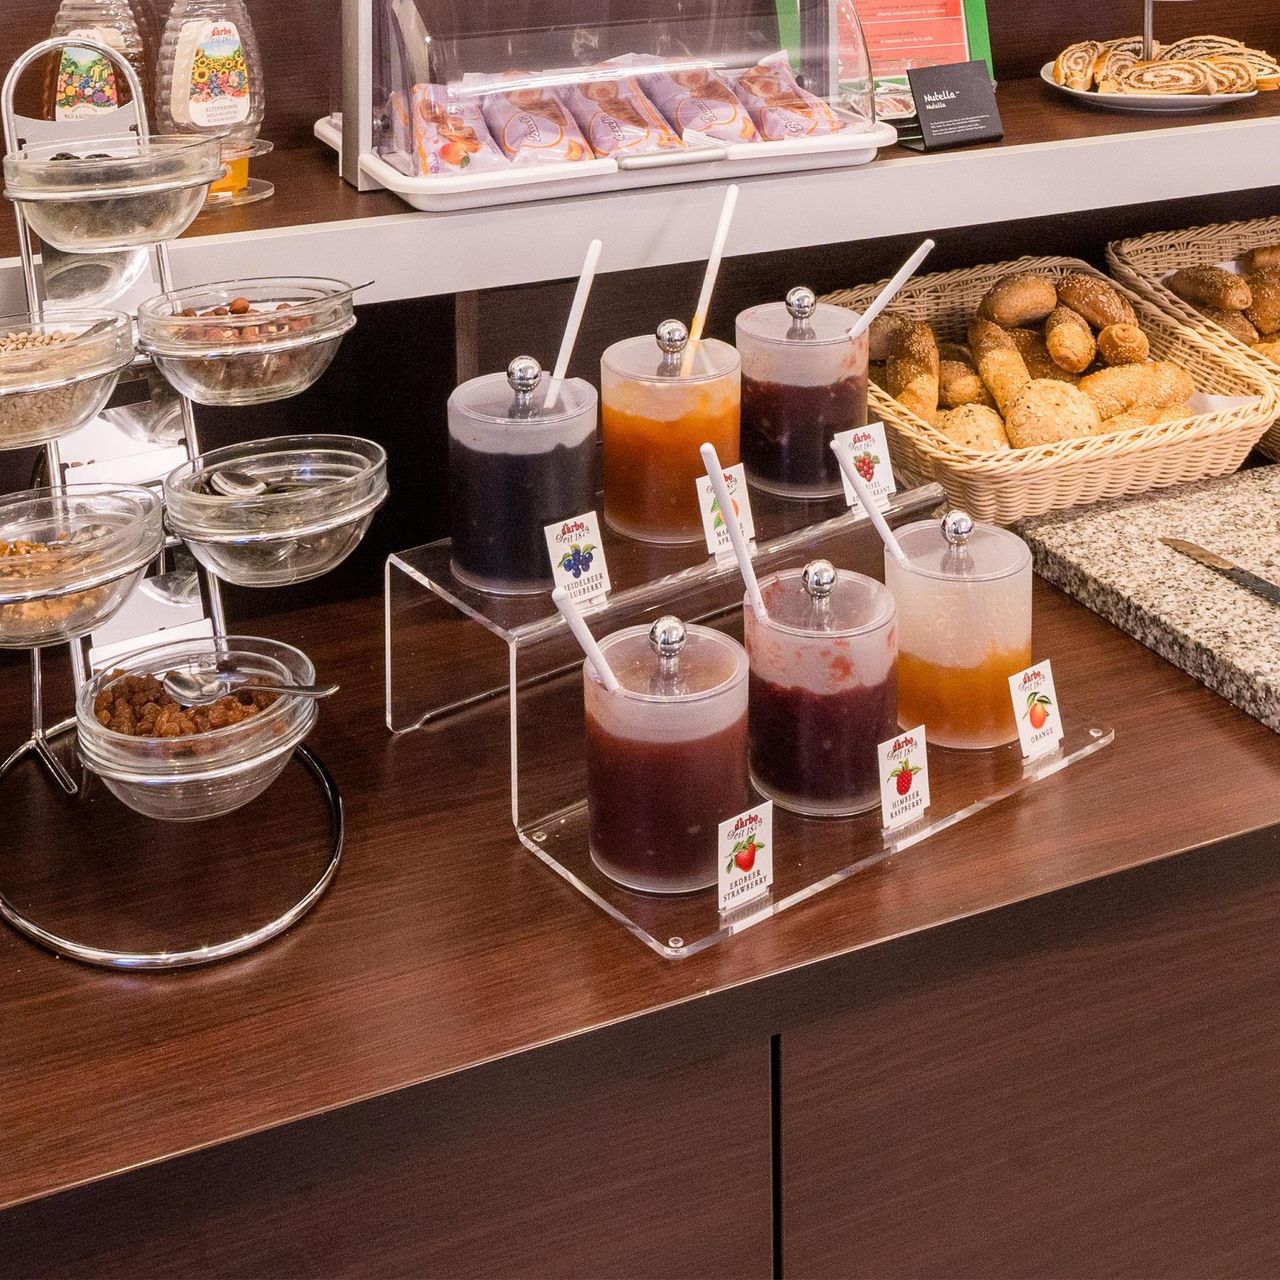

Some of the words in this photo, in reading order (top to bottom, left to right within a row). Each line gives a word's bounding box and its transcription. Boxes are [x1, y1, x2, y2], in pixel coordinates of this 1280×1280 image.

[924, 90, 956, 103] Nutella
[1030, 727, 1054, 744] ORANGE
[890, 799, 923, 820] RASPBERRY
[891, 790, 920, 809] HIMBEER
[723, 875, 768, 903] STRAWBERRY
[729, 869, 762, 890] ERDBEER
